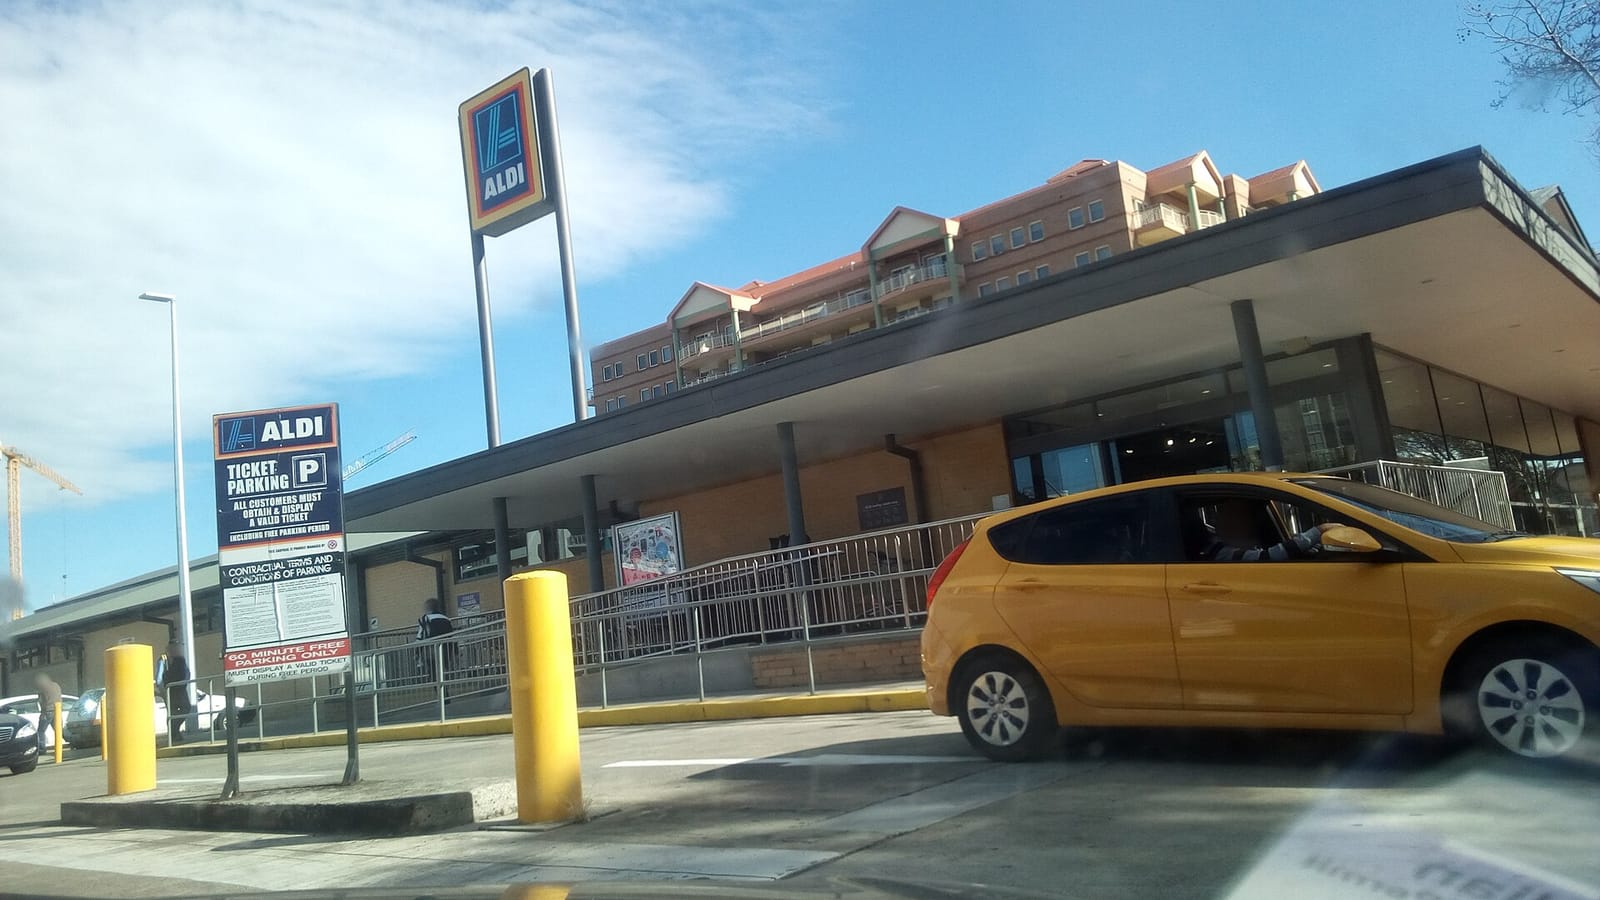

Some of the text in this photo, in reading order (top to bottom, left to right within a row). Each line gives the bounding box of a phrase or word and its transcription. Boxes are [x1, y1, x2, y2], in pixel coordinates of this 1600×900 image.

[484, 162, 525, 200] ALDI
[261, 416, 323, 442] ALDI
[227, 460, 278, 480] TICKET
[299, 459, 319, 483] P
[227, 474, 290, 495] PARKING
[234, 492, 322, 511] ALL CUSTOMERS MUST
[243, 502, 314, 519] OBTAIN & DISPLAY
[249, 512, 309, 527] A VALID TICKET
[279, 526, 306, 536] PARKING
[307, 523, 330, 533] PERIOD
[228, 554, 333, 577] CONTRACTUAL TERMS AND
[231, 564, 332, 586] CONDITIONS OF PARKING
[228, 640, 346, 661] 60 MINUTE FREE
[235, 648, 338, 667] PARKING ONLY
[228, 669, 249, 677] MUST
[252, 665, 285, 674] DISPLAY
[295, 661, 317, 669] VALID
[320, 657, 347, 665] TICKET
[247, 673, 277, 681] DURING
[300, 666, 329, 674] PERIOD
